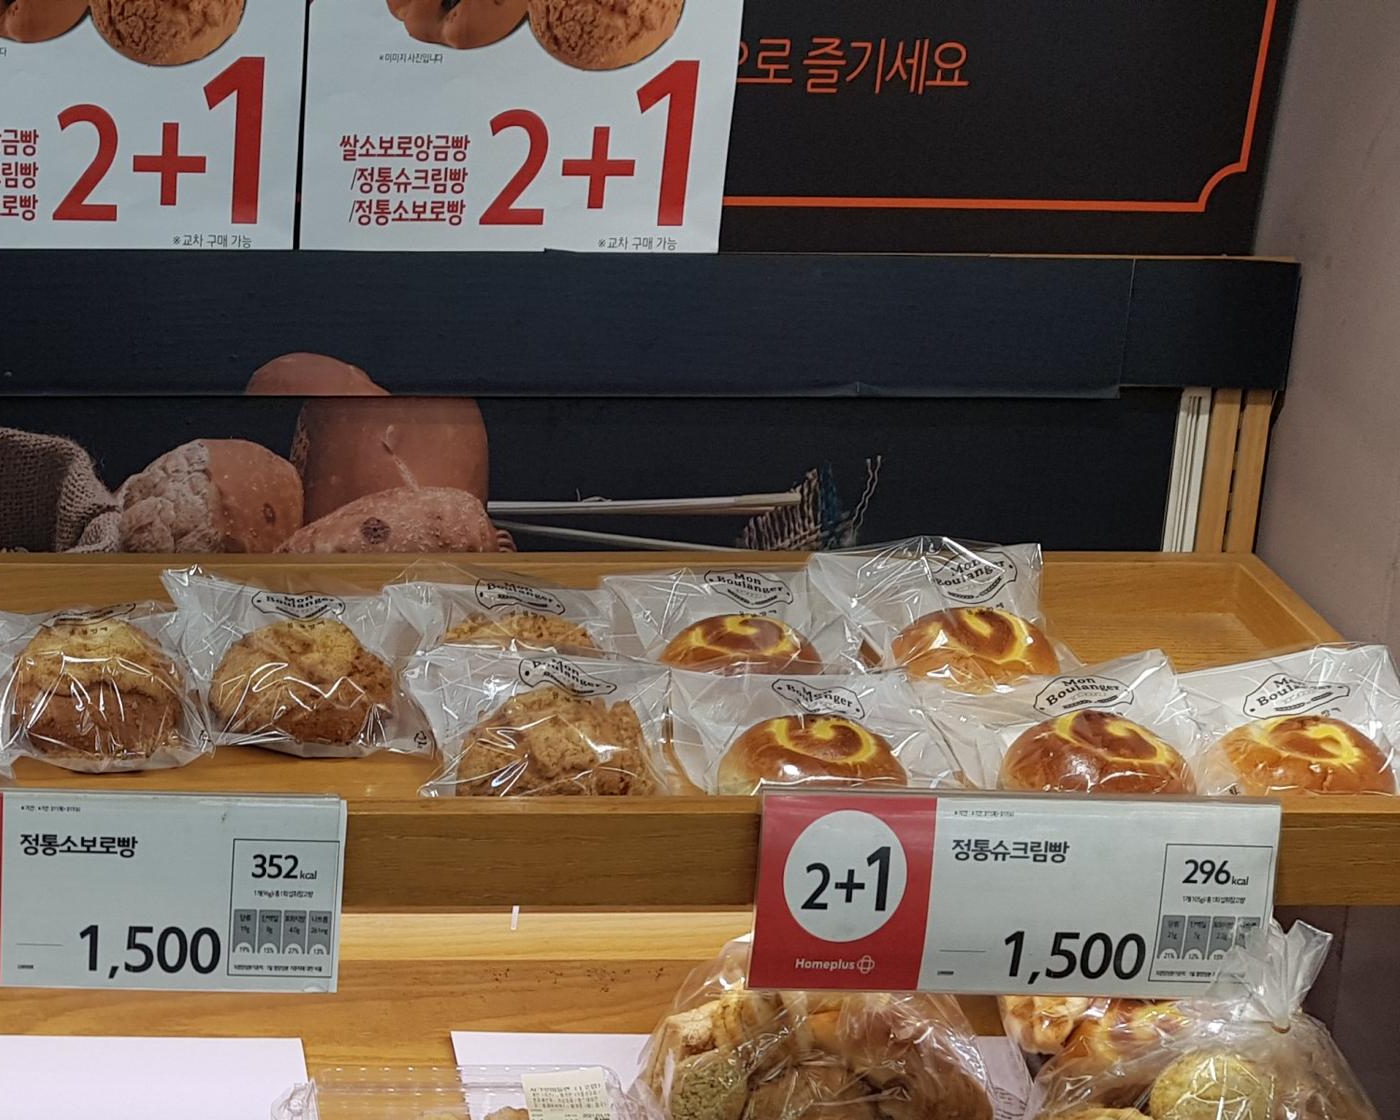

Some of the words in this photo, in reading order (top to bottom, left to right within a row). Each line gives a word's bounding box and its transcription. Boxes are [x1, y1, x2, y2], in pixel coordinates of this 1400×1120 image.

[802, 36, 970, 95] 즐기세요
[52, 56, 265, 225] 2+1
[339, 134, 471, 162] 쌀소보로앙금빵
[479, 59, 701, 227] 2+1
[349, 167, 468, 195] /정통슈크림빵
[348, 199, 466, 227] /정통소보로빵
[206, 235, 228, 249] 구매
[230, 235, 253, 249] 가능
[631, 236, 654, 251] 구매
[656, 236, 677, 251] 가능
[717, 576, 783, 594] Boulanger
[734, 572, 762, 585] Mon
[1045, 684, 1120, 706] Boulanger
[1062, 677, 1096, 687] Mon
[20, 833, 138, 858] 정통소보로빵
[951, 838, 1070, 863] 정통슈크림빵
[251, 854, 299, 880] 352
[299, 869, 318, 880] kcal
[800, 846, 892, 912] 2+1
[1182, 859, 1231, 885] 296
[1231, 876, 1249, 886] kcal
[79, 924, 222, 979] 1,500
[1003, 930, 1147, 985] 1,500
[795, 957, 855, 973] Homeplus
